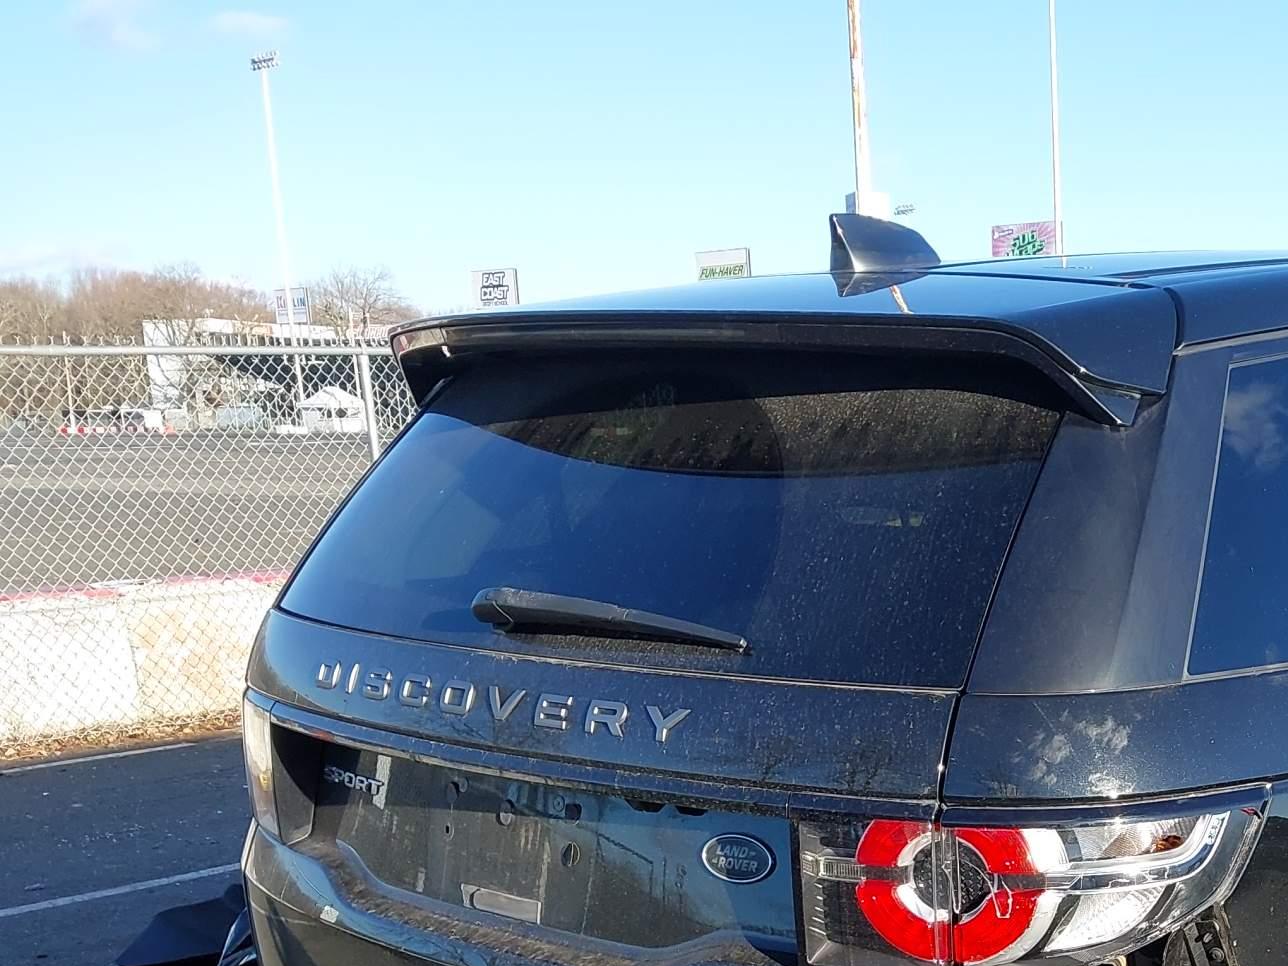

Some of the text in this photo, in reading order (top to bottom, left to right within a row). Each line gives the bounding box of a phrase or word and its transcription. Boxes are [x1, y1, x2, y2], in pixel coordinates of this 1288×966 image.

[482, 271, 505, 287] EAST
[480, 285, 509, 301] COAST
[315, 659, 692, 743] DISCOVERY
[323, 766, 384, 796] SPORT
